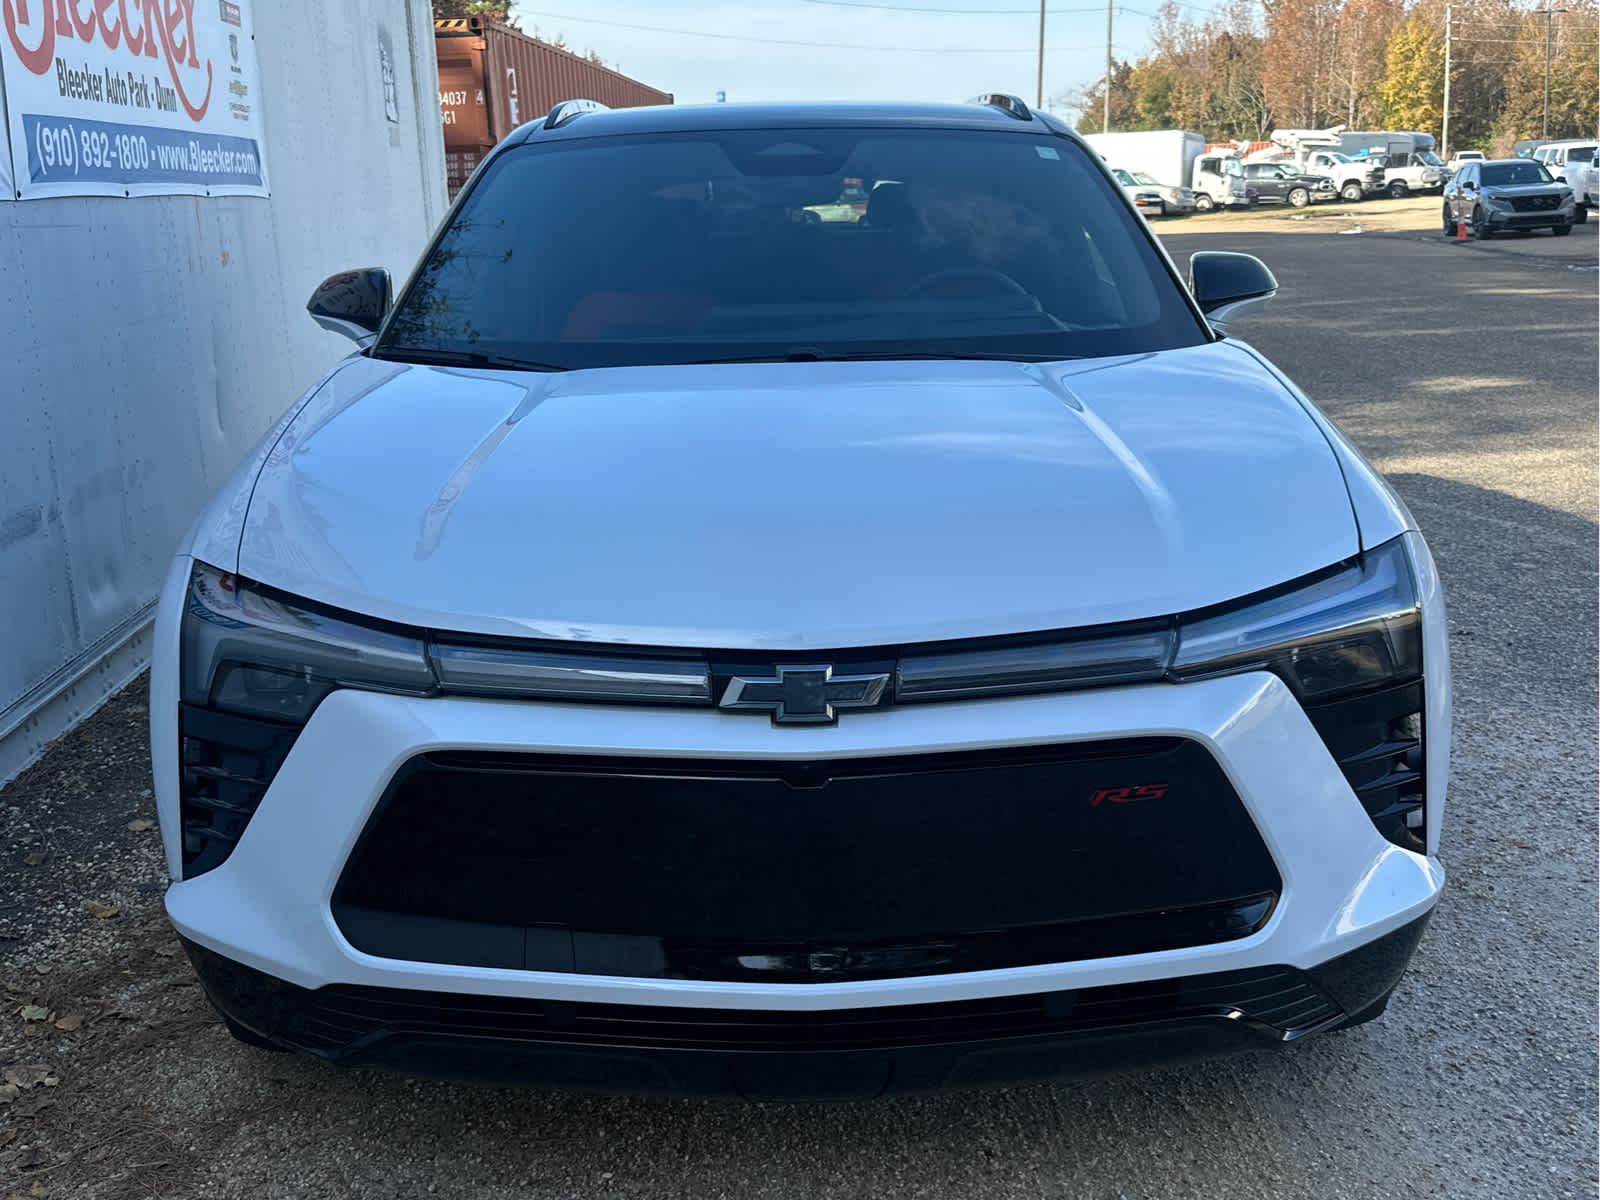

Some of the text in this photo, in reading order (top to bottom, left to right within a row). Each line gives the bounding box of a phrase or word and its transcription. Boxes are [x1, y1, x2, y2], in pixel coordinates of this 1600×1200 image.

[55, 57, 178, 112] Bleecker Auto Park Dunn
[36, 121, 257, 175] (910) 892-1800 www.Bleecker.com
[1088, 783, 1168, 806] RS
